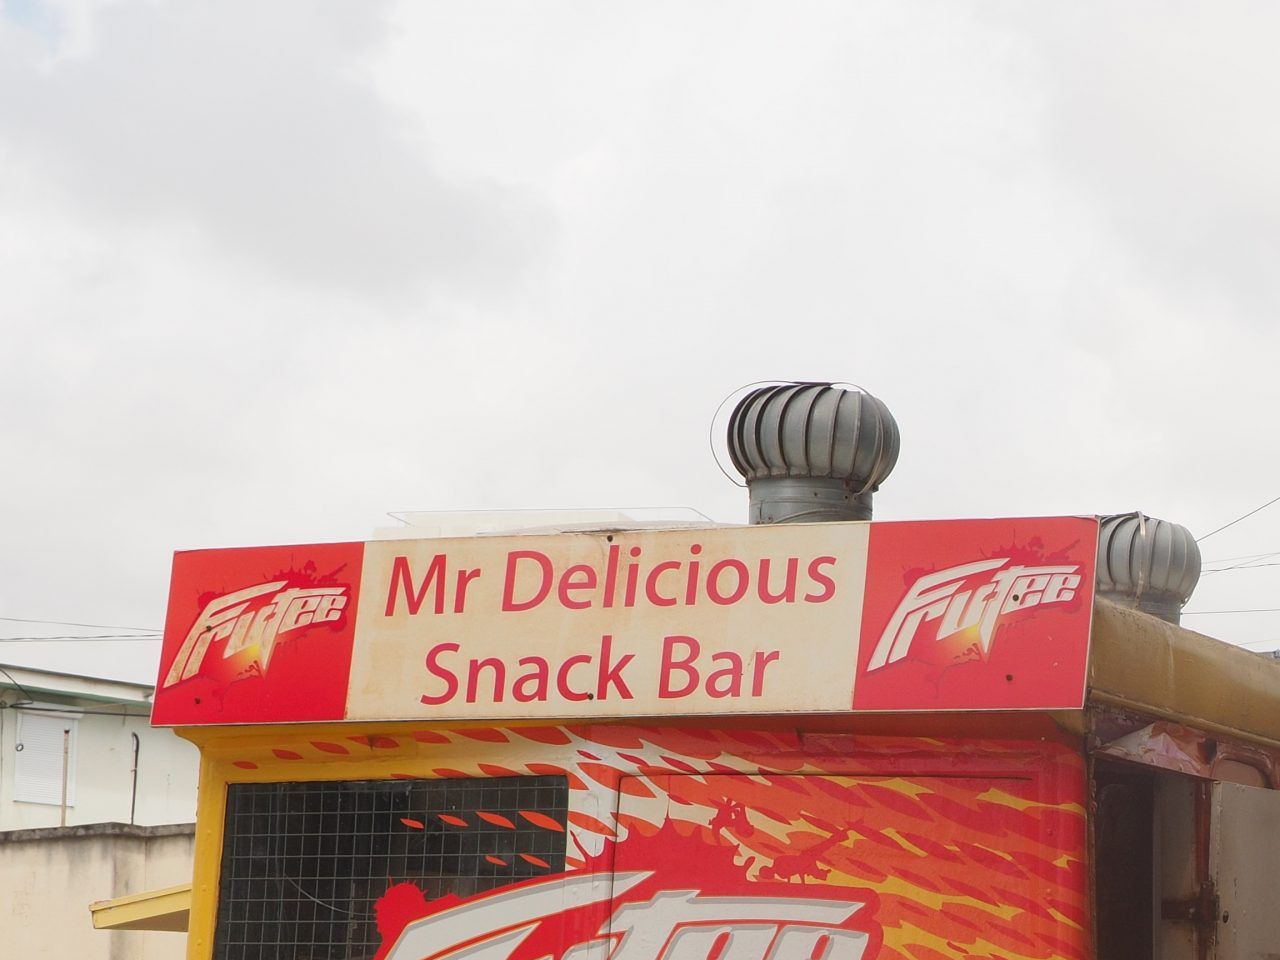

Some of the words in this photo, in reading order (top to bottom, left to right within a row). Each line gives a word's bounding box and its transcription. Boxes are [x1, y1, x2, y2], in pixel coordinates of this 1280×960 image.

[383, 553, 481, 617] Mr
[501, 543, 837, 613] Delicious
[420, 635, 636, 705] Snack
[658, 634, 779, 699] Bar
